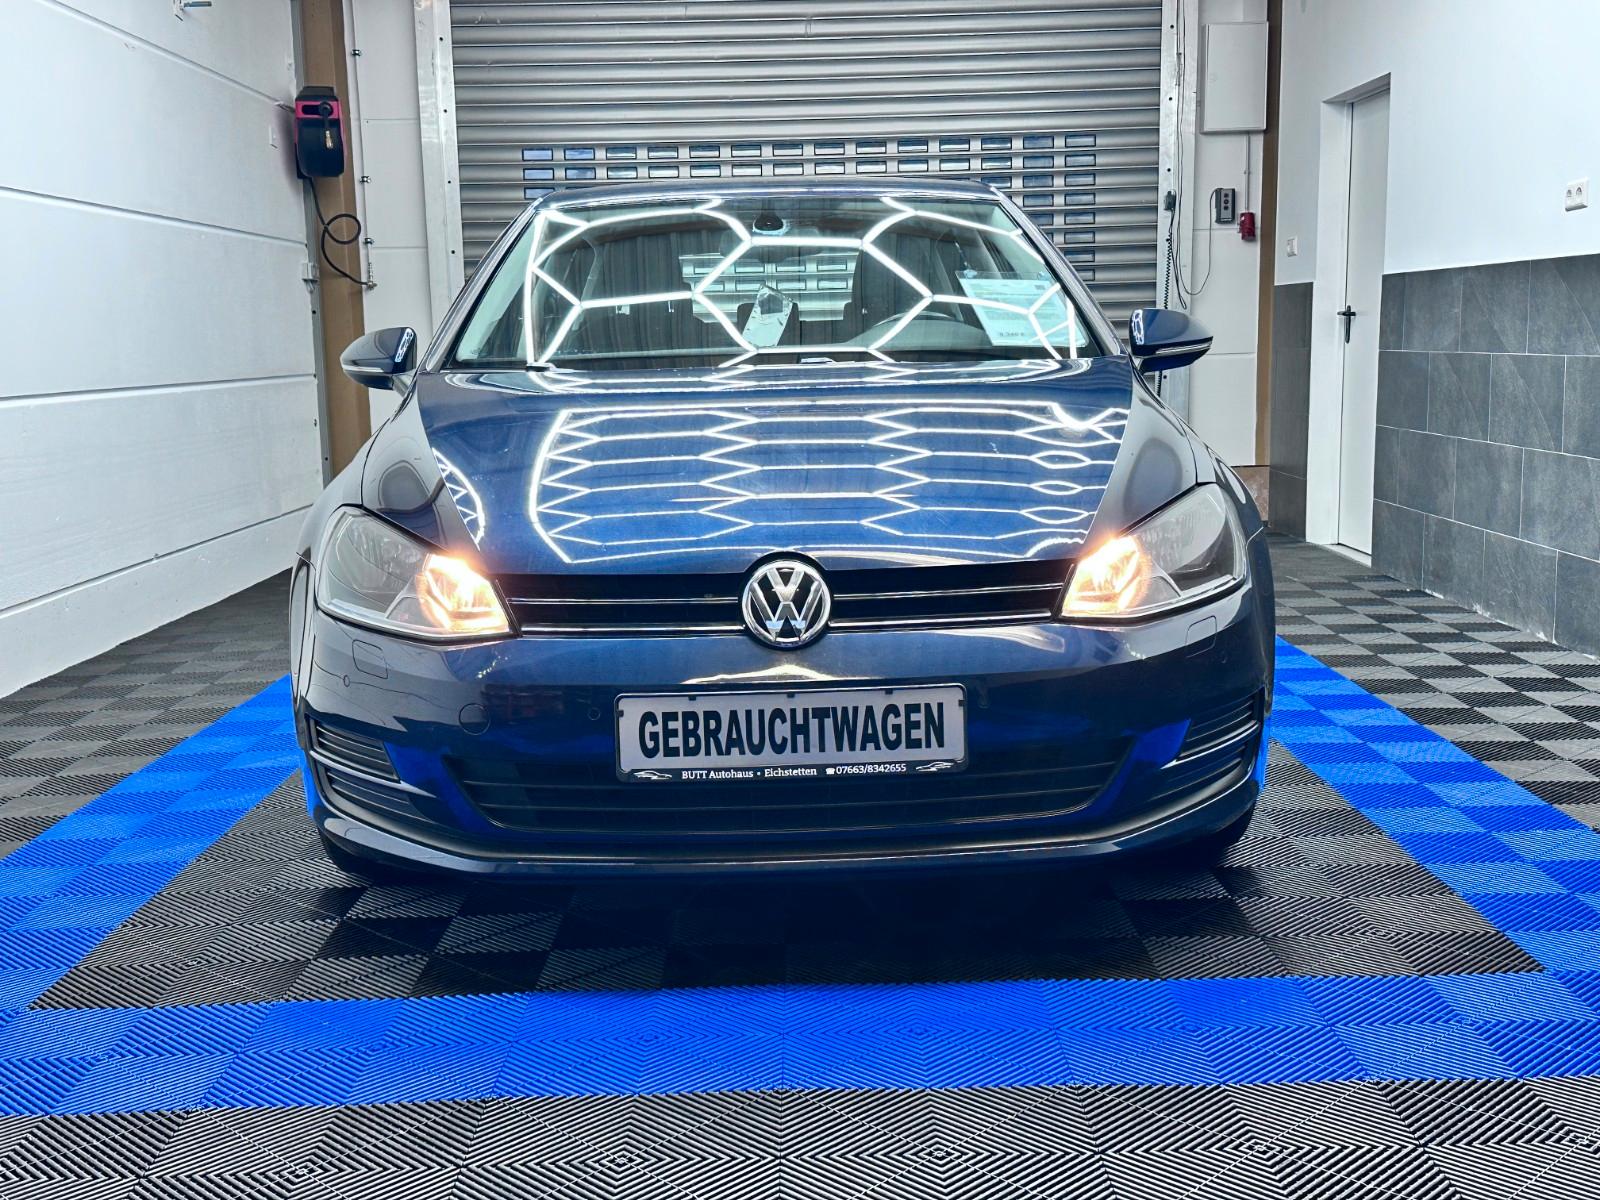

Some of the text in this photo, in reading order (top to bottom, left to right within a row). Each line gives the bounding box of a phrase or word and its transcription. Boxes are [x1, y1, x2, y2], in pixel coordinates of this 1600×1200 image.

[746, 564, 826, 642] VW
[638, 702, 945, 759] GEBRAUCHTWAGEN
[681, 770, 708, 780] BUTT
[708, 769, 754, 779] Autohaus
[764, 767, 817, 777] Eichstetten
